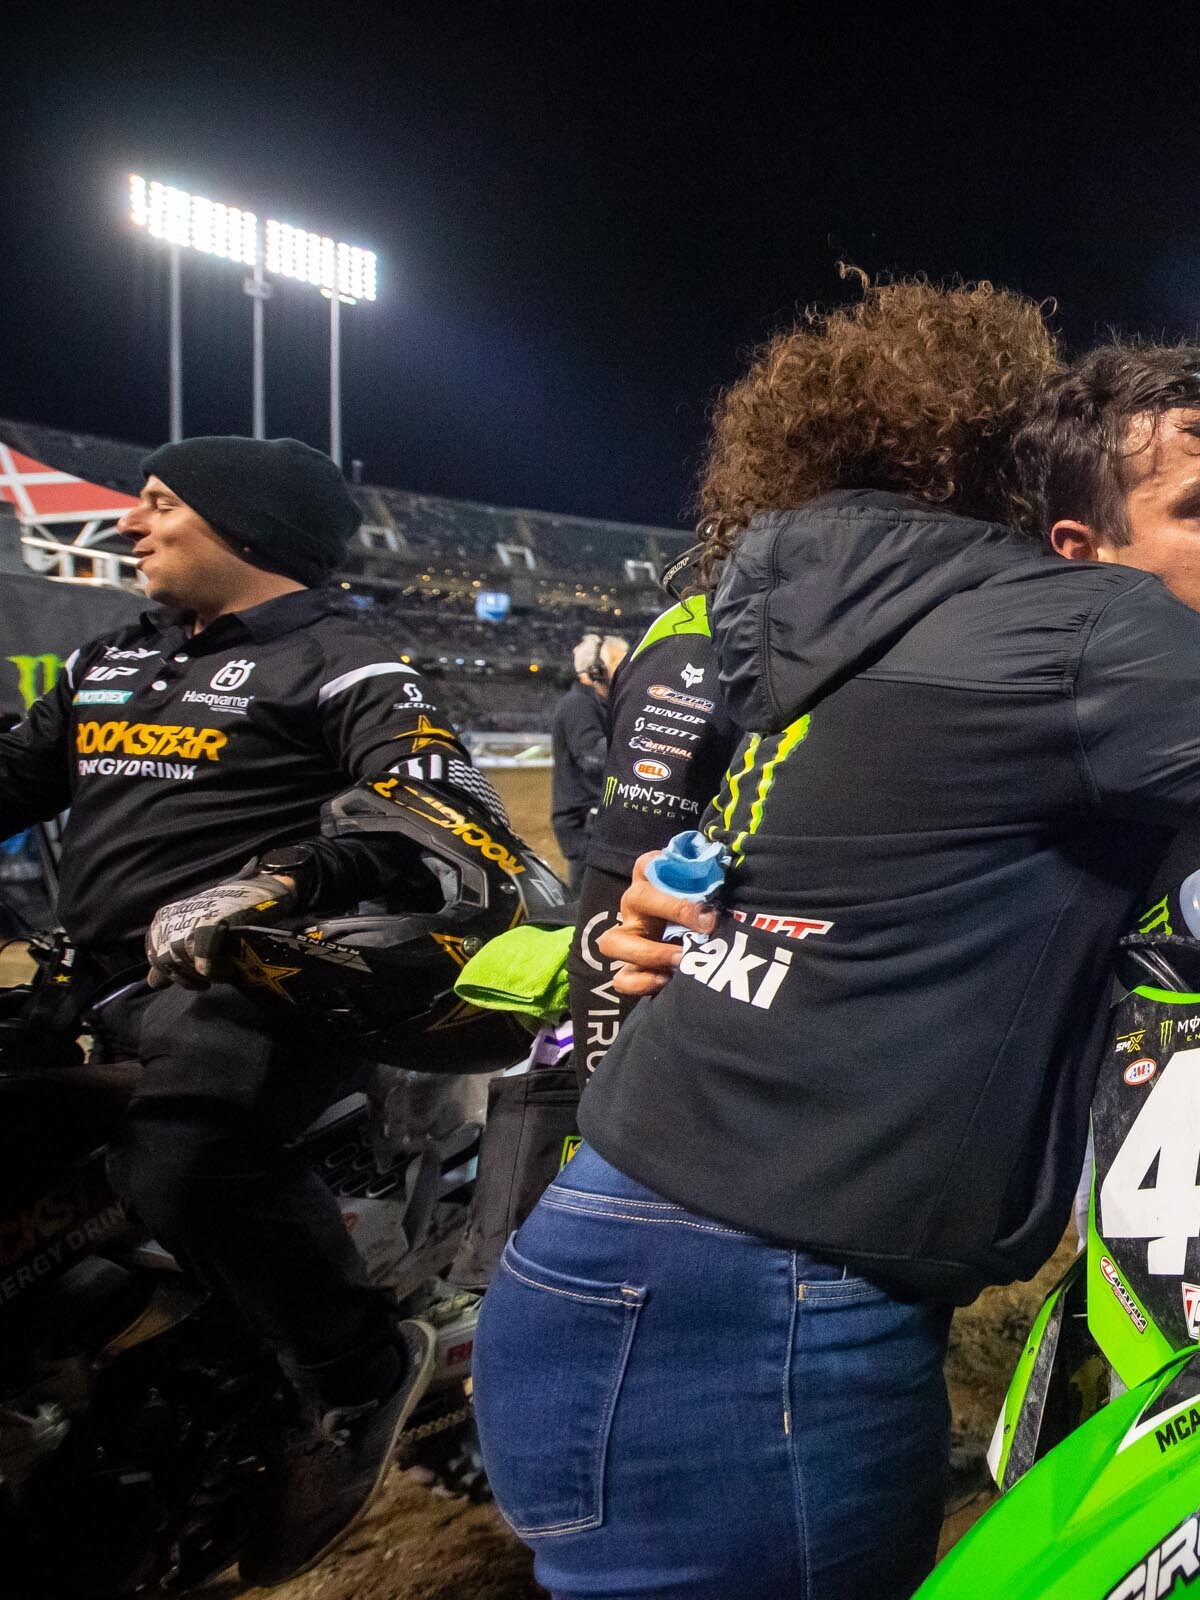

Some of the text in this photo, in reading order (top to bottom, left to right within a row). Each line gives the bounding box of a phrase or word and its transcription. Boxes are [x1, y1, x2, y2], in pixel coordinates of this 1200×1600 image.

[182, 690, 249, 708] Husqvarna
[642, 704, 707, 725] DUNLOP
[645, 722, 702, 741] SCOTT
[645, 740, 693, 759] RENTHAL
[638, 764, 664, 778] BELL
[1114, 1034, 1144, 1053] SMX
[1128, 1063, 1151, 1080] AMA
